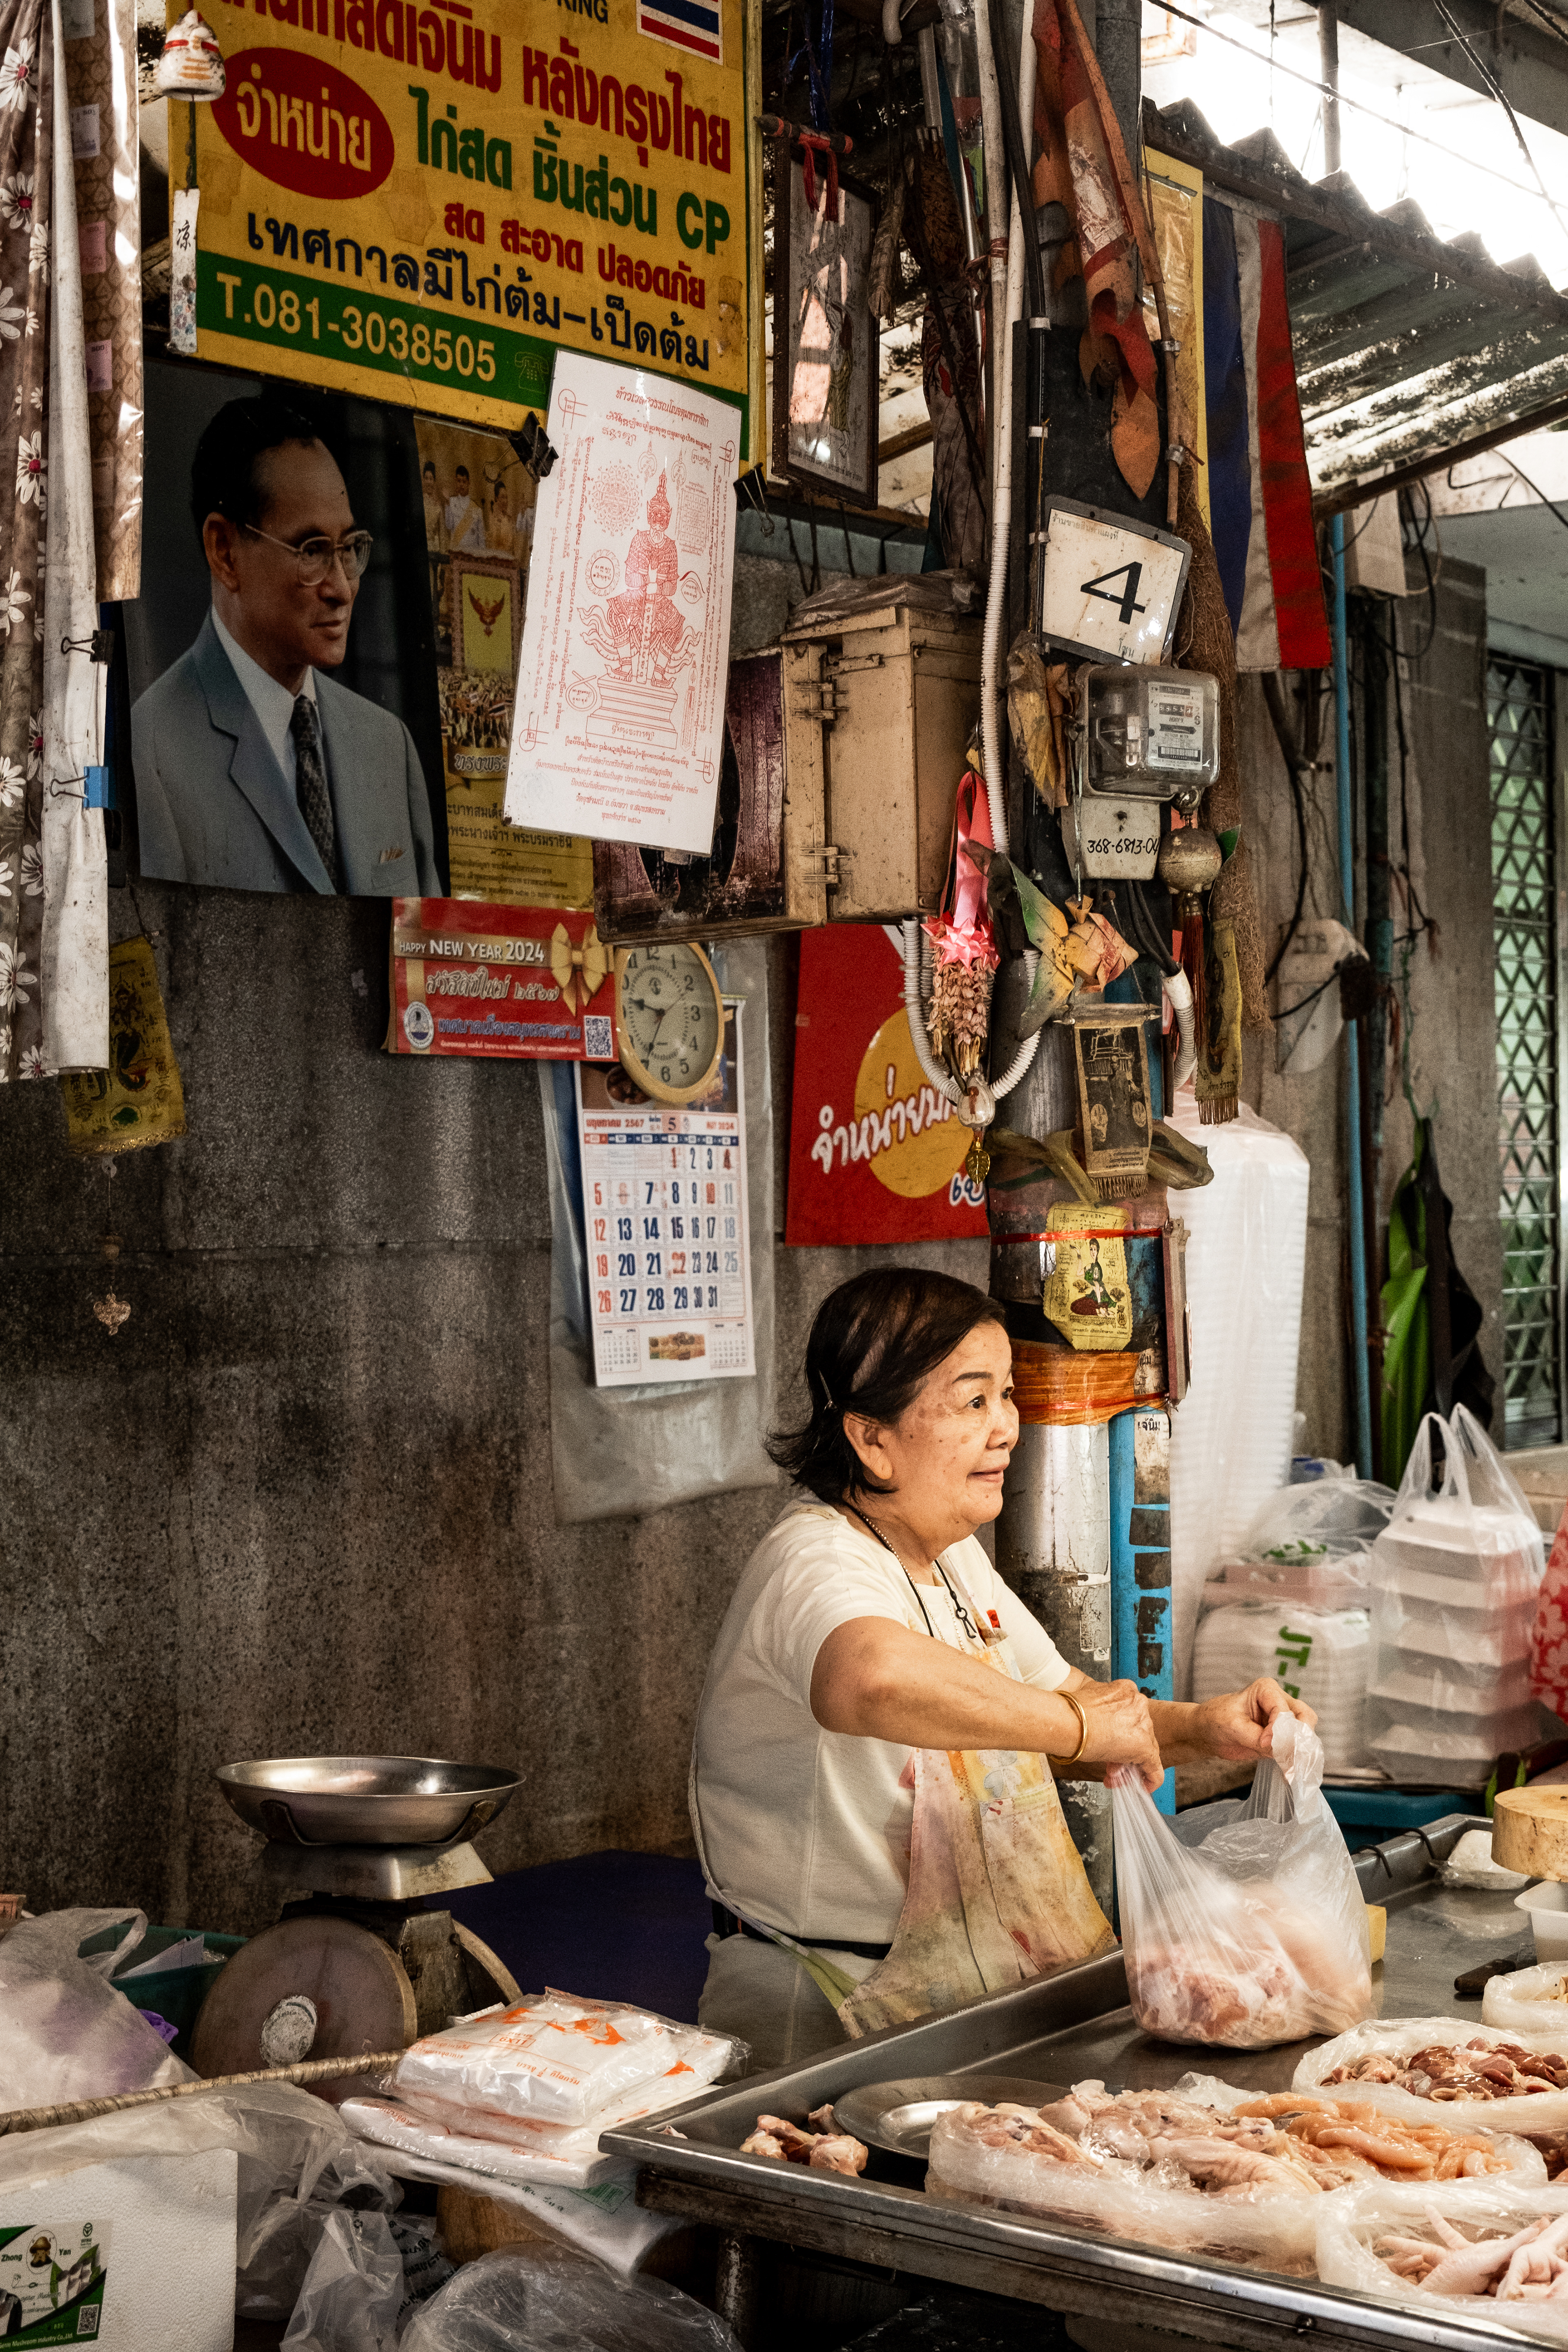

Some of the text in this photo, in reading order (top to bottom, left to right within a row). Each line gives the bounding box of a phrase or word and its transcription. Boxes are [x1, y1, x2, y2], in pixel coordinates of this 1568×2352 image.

[237, 63, 372, 172] จำหน่าย
[523, 36, 731, 174] หลังกรุงไทย
[408, 84, 731, 254] ไก่สด ชิ้นส่วน CP
[444, 203, 705, 310] สด สะอาด ปลอดภัย
[217, 272, 496, 382] T.081-3038505
[1080, 561, 1145, 625] 4
[399, 940, 545, 962] HAPPY NEW YEAR 2024
[690, 1004, 701, 1021] 3
[672, 1147, 677, 1169] 1
[690, 1147, 696, 1169] 2
[707, 1148, 713, 1169] 3
[594, 1183, 602, 1205] 5
[646, 1182, 654, 1204] 7
[672, 1181, 679, 1204] 8
[595, 1218, 606, 1241] 12
[618, 1218, 632, 1240] 13
[644, 1217, 660, 1240] 14
[671, 1216, 684, 1239] 15
[618, 1253, 636, 1276] 20
[646, 1252, 662, 1275] 21
[707, 1251, 718, 1273] 24
[620, 1288, 637, 1312] 27
[647, 1287, 664, 1310] 28
[674, 1286, 688, 1309] 29
[708, 1285, 718, 1307] 31
[1, 2254, 23, 2262] Zhong
